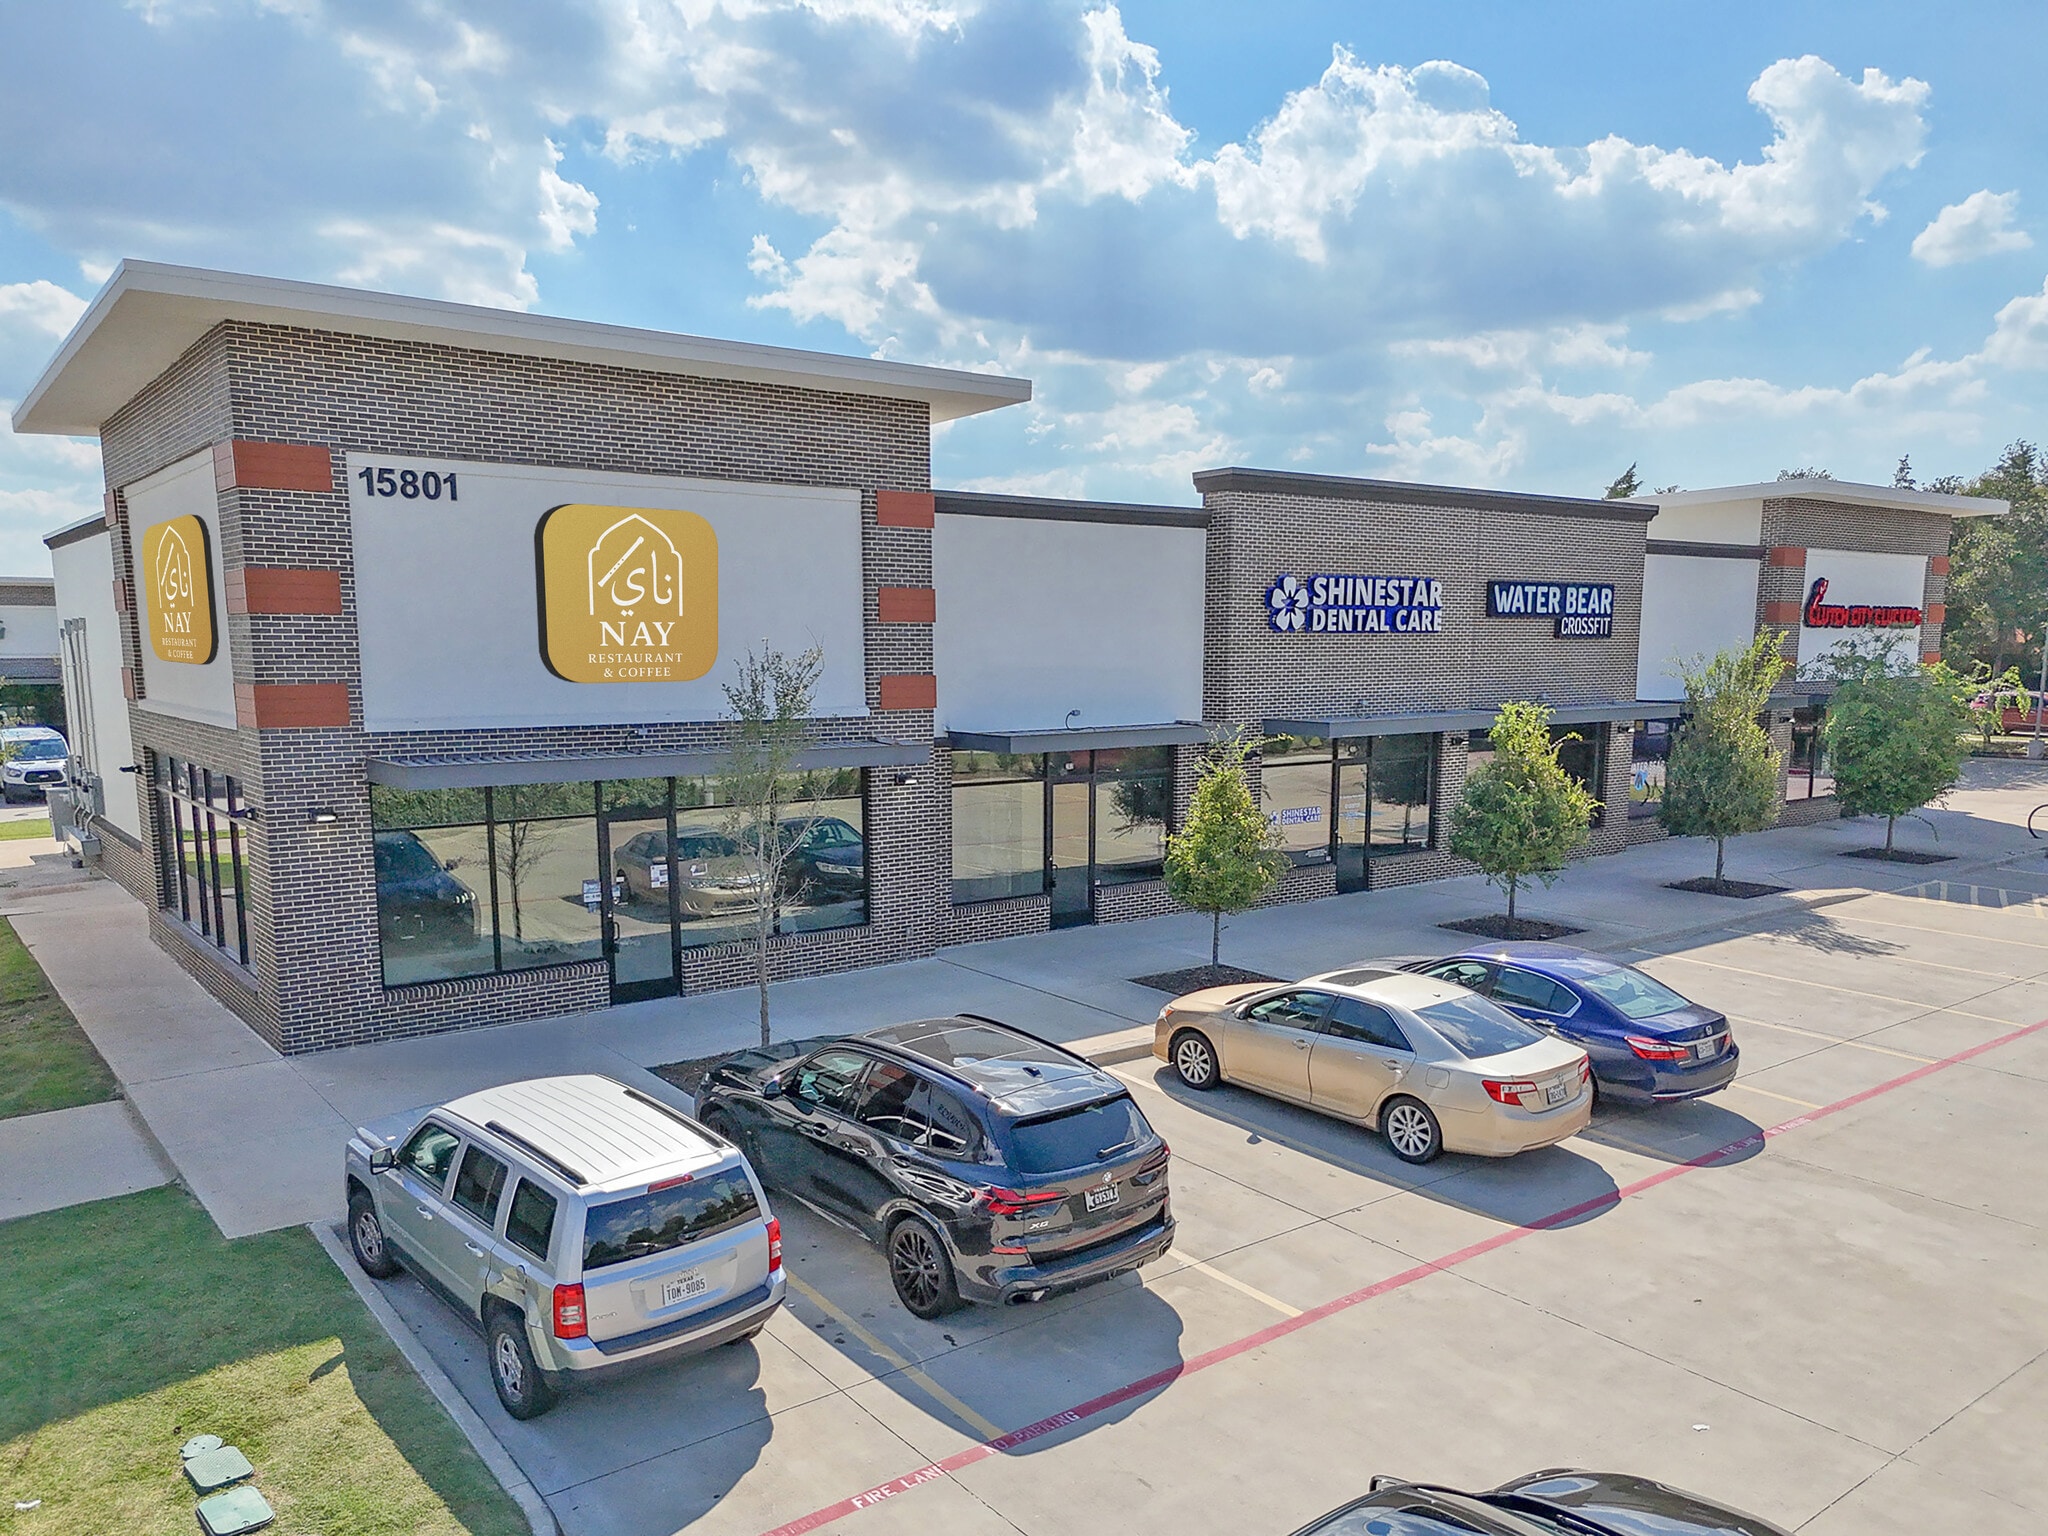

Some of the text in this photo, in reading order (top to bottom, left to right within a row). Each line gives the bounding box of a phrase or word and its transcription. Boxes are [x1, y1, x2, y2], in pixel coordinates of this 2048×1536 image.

[358, 466, 459, 502] 15801
[611, 550, 673, 617] ناي
[1312, 577, 1443, 608] SHINESTAR
[1493, 583, 1612, 615] WATER BEAR
[164, 612, 191, 633] NAY
[1311, 609, 1442, 632] DENTAL CARE
[1561, 617, 1611, 636] CROSSFIT
[1852, 605, 1873, 627] CITY
[161, 637, 197, 648] RESTAURANT
[599, 621, 676, 647] NAY
[173, 649, 194, 659] COFFEE
[588, 652, 683, 664] RESTAURANT
[604, 667, 672, 678] & COFFEE
[1281, 815, 1322, 825] DENTAL CARE
[1282, 806, 1322, 818] SHINESTAR
[676, 1276, 694, 1285] TEXAS
[981, 1410, 1081, 1455] NO PARKING
[852, 1463, 951, 1508] FIRE LANE
